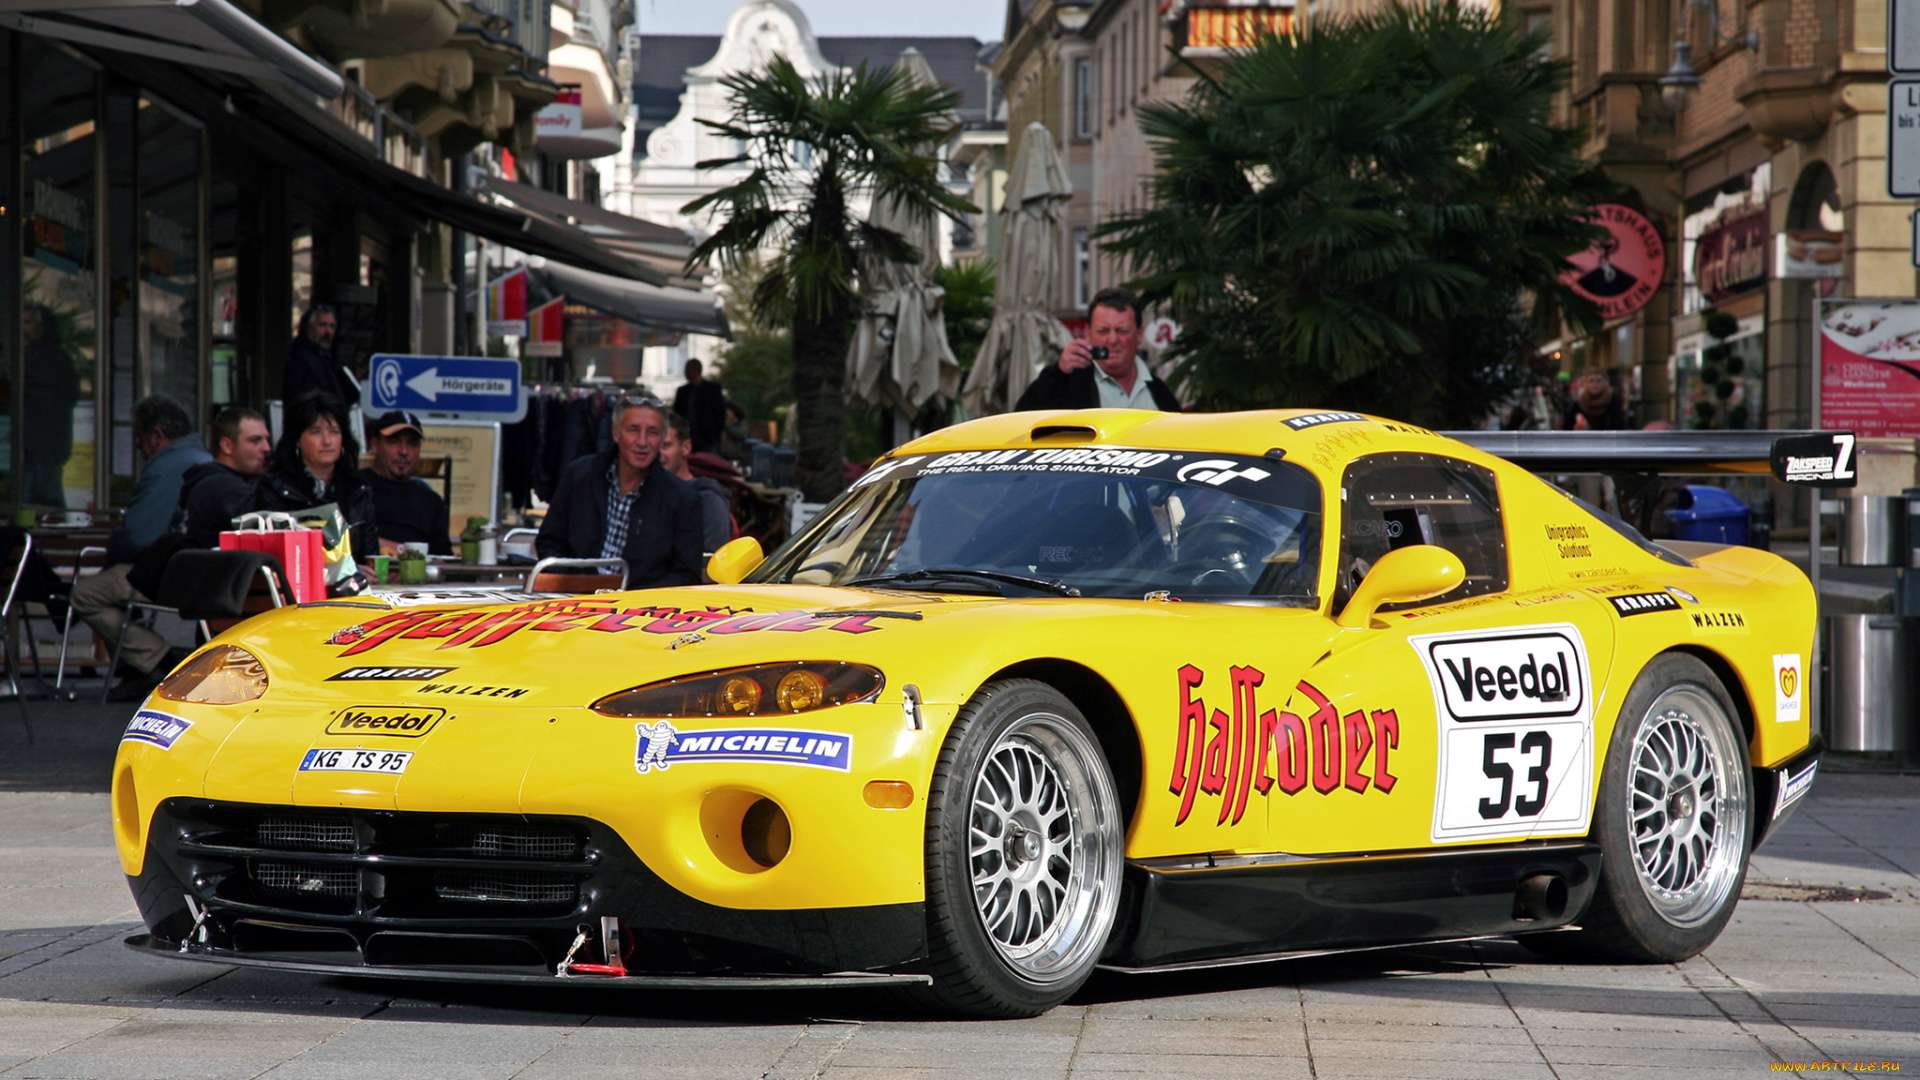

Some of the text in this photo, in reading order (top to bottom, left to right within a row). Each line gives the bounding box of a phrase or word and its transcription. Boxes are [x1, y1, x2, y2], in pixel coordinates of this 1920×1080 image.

[442, 379, 505, 392] Hörgeräte
[1289, 412, 1361, 428] KRAFFT
[926, 448, 1171, 469] GRAN TURISMO
[1786, 456, 1833, 473] ZAKSPEED
[1832, 434, 1855, 480] Z
[916, 464, 1141, 476] THE REAL DRIVING SIMULATOR
[1786, 472, 1833, 482] RACING
[1544, 523, 1590, 541] Unigraphics
[1557, 543, 1593, 559] Solutions
[1614, 593, 1676, 612] KRAFFT
[1691, 612, 1745, 628] WALZEN
[341, 668, 447, 679] KRAFFT
[1442, 651, 1571, 702] Veedol
[416, 684, 530, 699] WALZEN
[128, 714, 184, 739] MICHELIN
[340, 711, 434, 732] Veedol
[678, 735, 843, 758] MICHELIN
[313, 750, 408, 771] KG TS 95
[1478, 730, 1553, 820] 53
